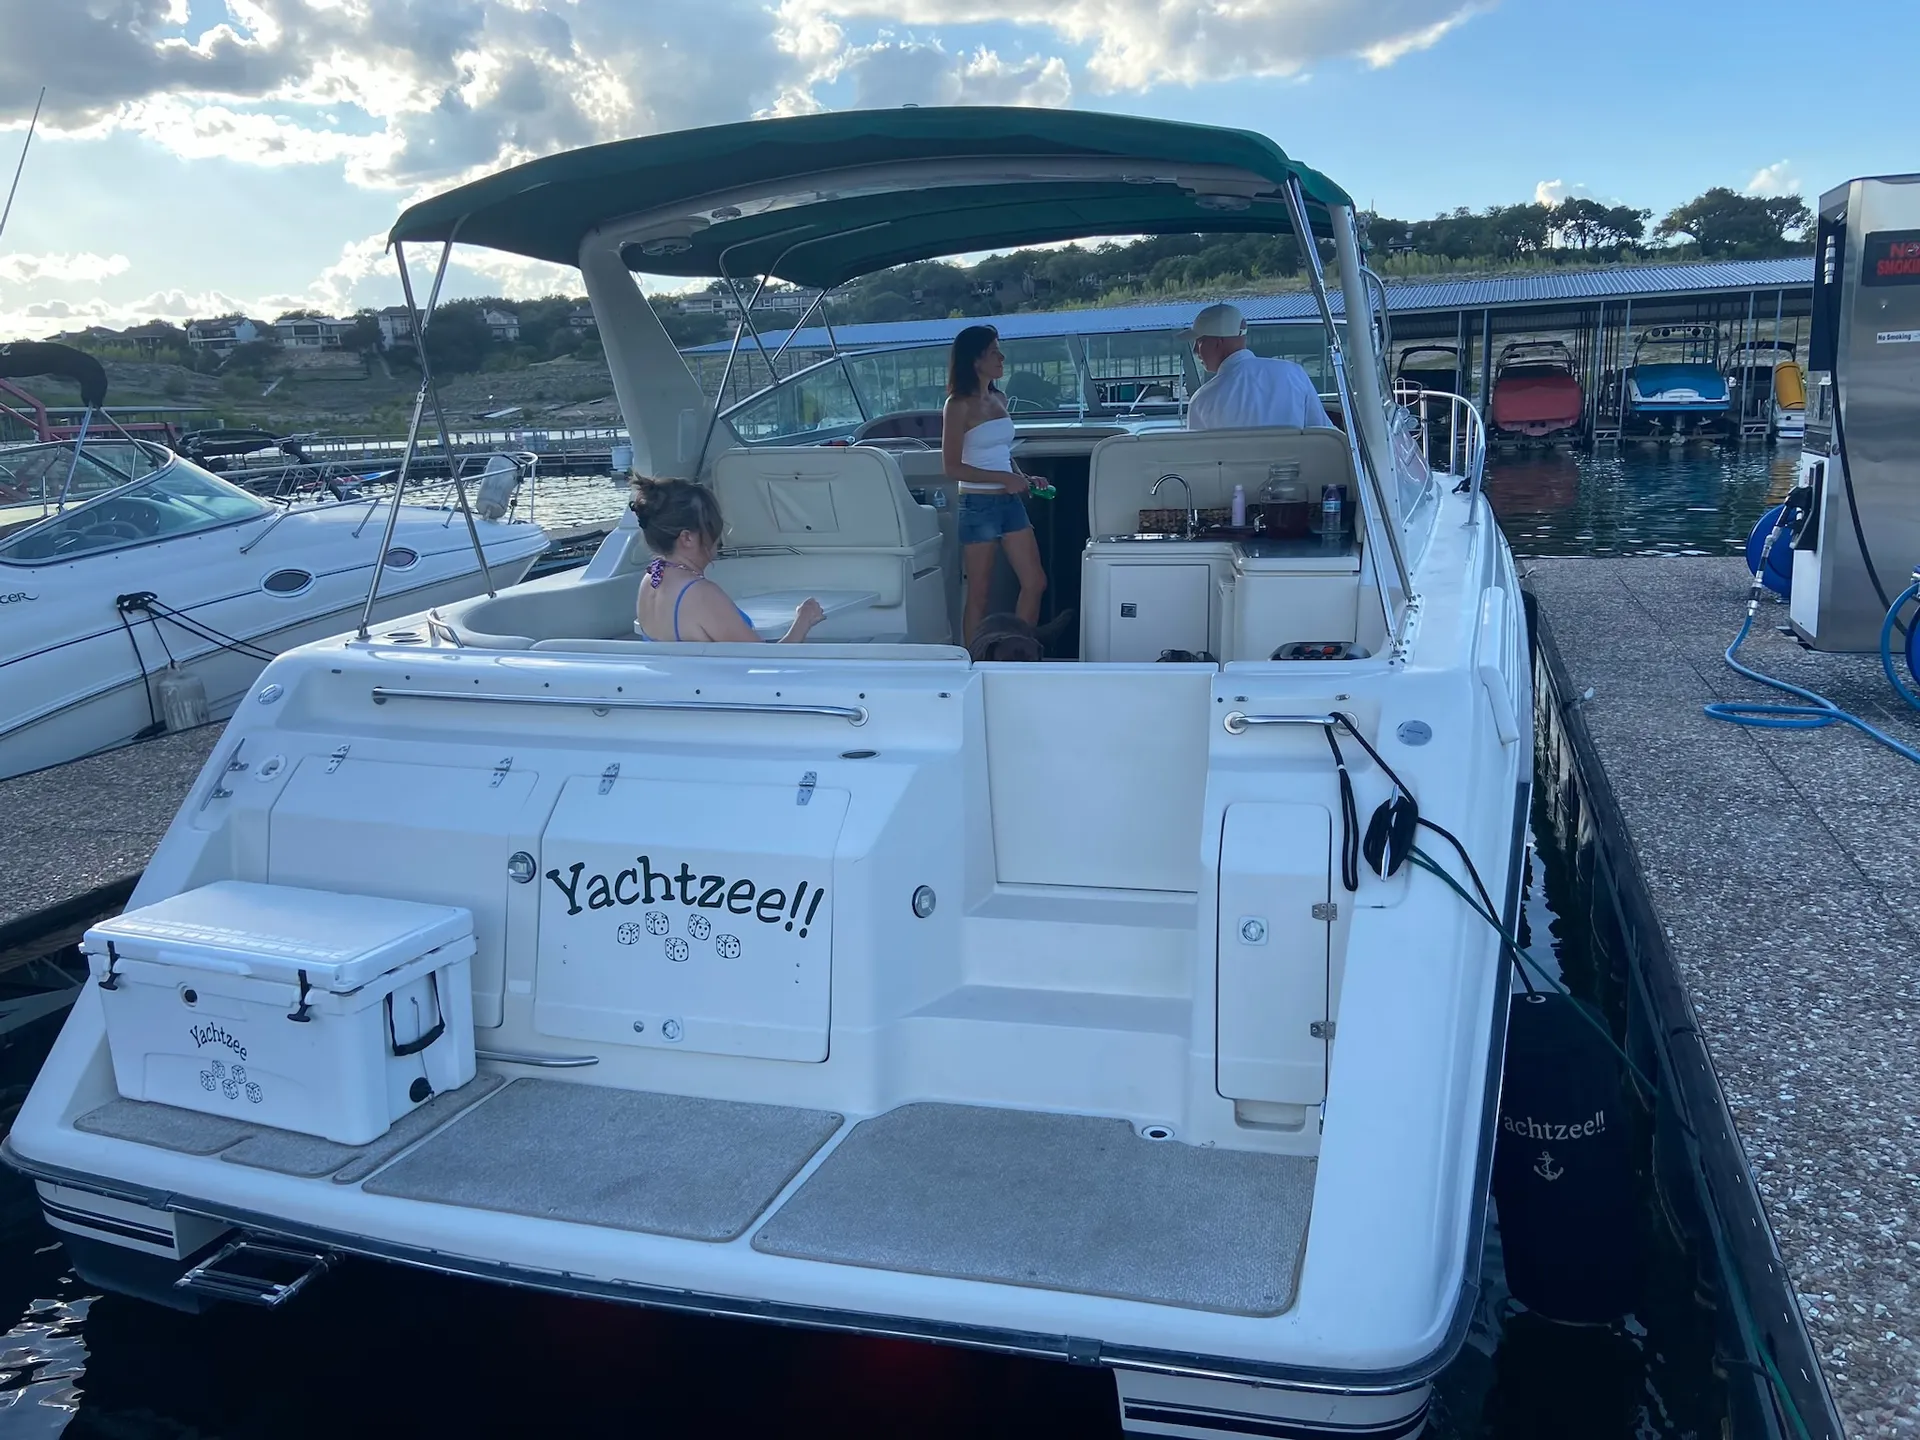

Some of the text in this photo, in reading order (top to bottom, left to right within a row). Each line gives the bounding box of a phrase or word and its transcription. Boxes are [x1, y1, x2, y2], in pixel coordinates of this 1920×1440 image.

[1890, 242, 1920, 259] NO
[1887, 332, 1911, 342] Smoking
[546, 855, 825, 939] Yachtzee!!
[189, 1021, 248, 1062] Yachtzee
